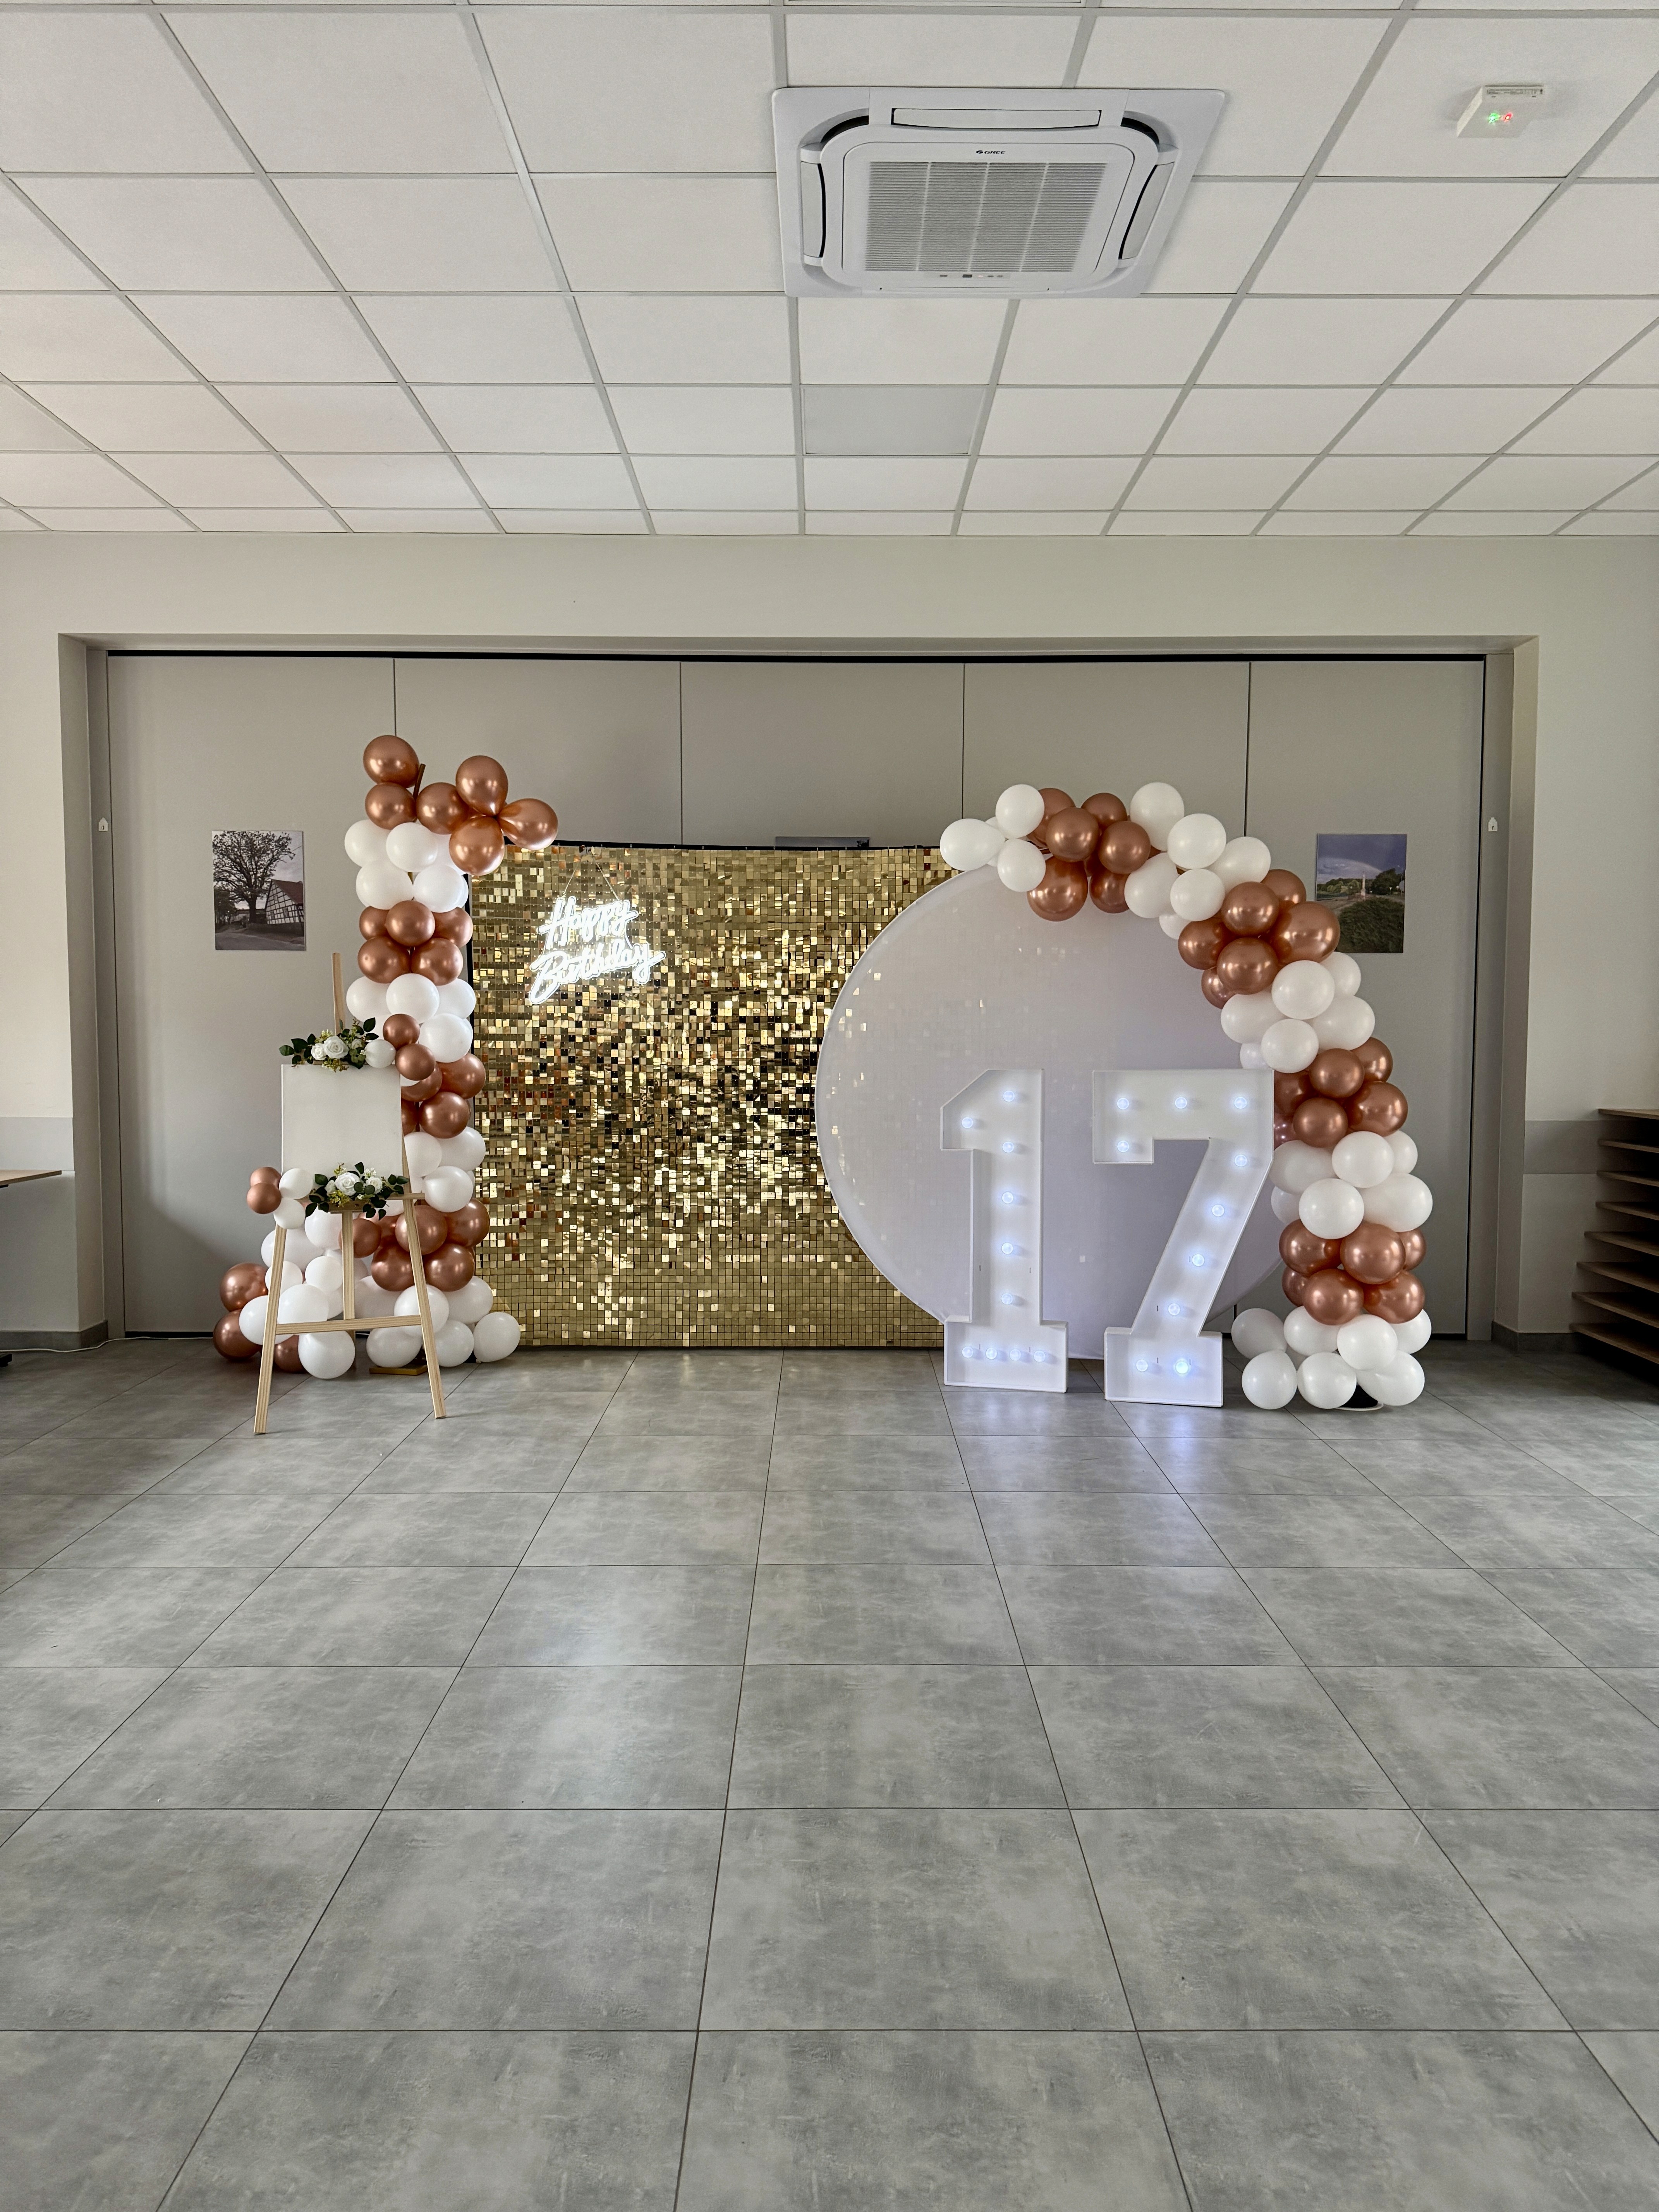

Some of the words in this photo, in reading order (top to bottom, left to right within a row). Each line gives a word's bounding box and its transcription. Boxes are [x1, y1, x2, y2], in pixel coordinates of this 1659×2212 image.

[536, 895, 639, 949] Happy
[529, 939, 666, 1005] Birthday
[940, 1068, 1274, 1407] 17
